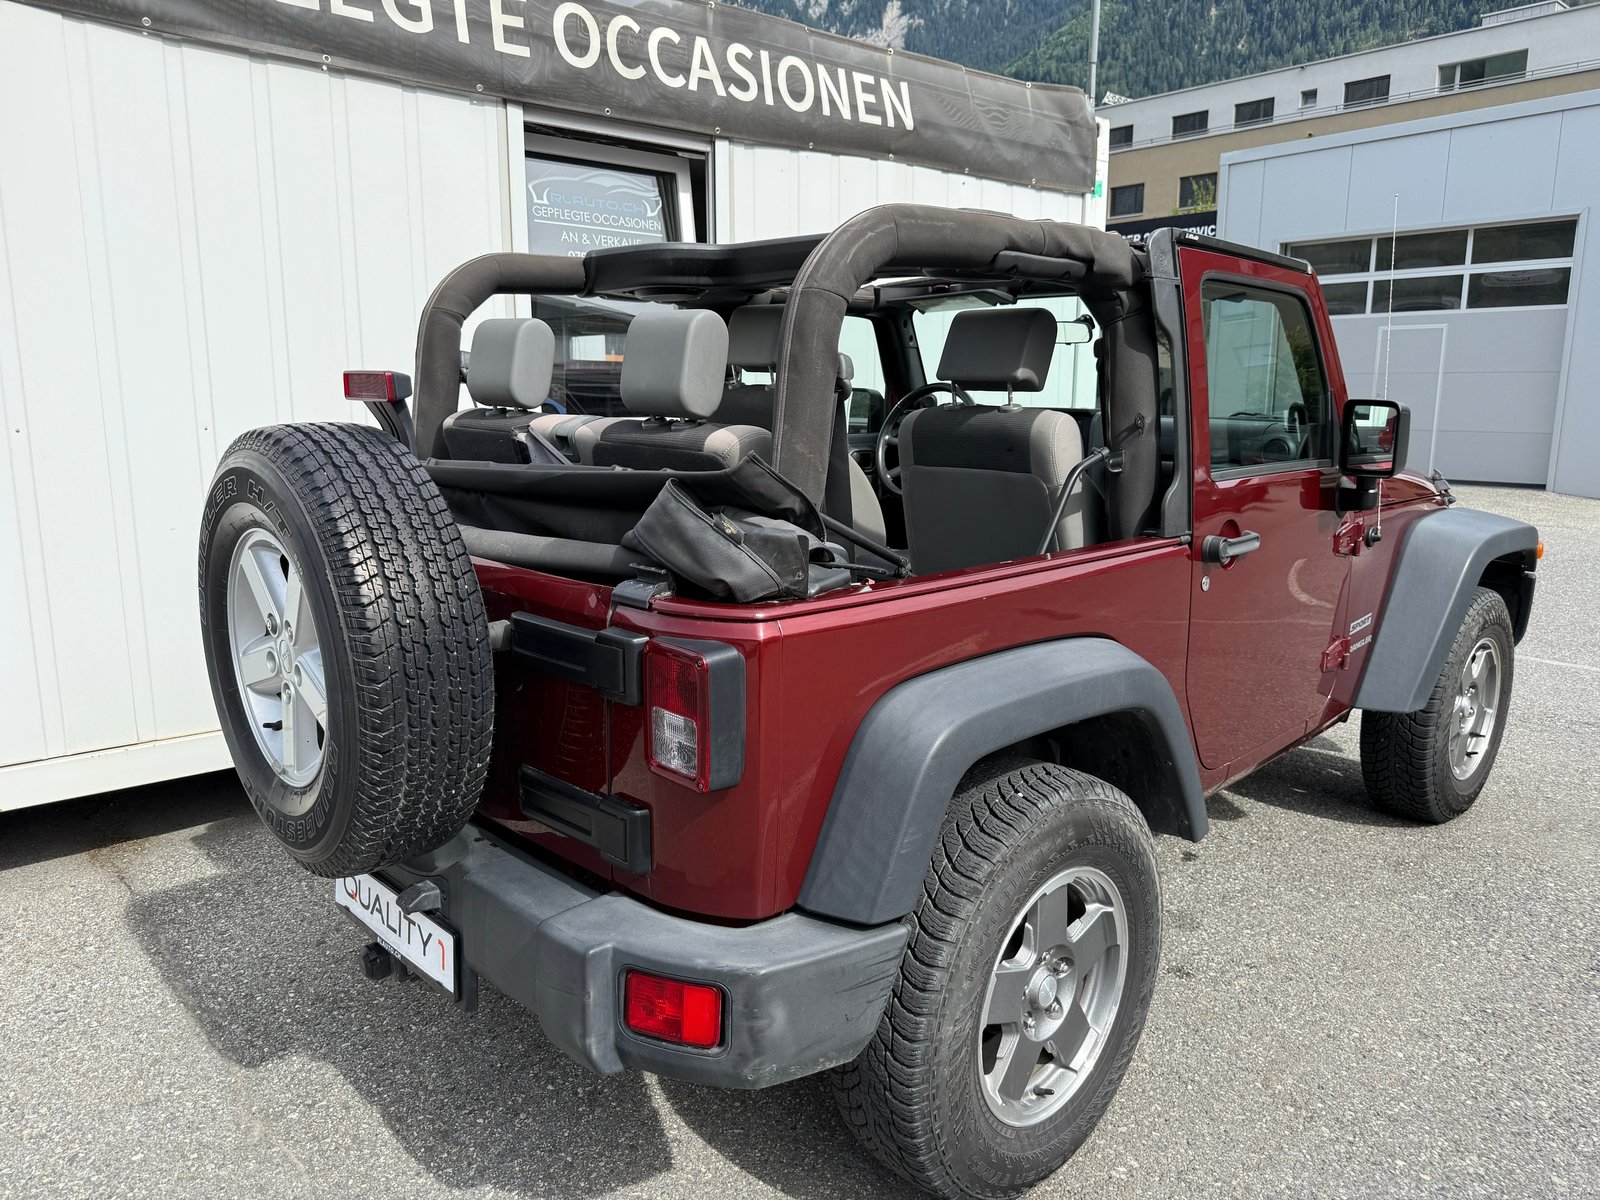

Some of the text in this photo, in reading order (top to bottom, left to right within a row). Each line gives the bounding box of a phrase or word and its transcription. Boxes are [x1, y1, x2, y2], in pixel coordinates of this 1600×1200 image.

[552, 2, 915, 131] OCCASIONEN
[532, 205, 662, 231] GEPFLEGTE OCCASIONEN
[560, 230, 579, 243] AN
[581, 233, 591, 245] &
[247, 478, 293, 541] H/T
[343, 874, 433, 957] QUALITY
